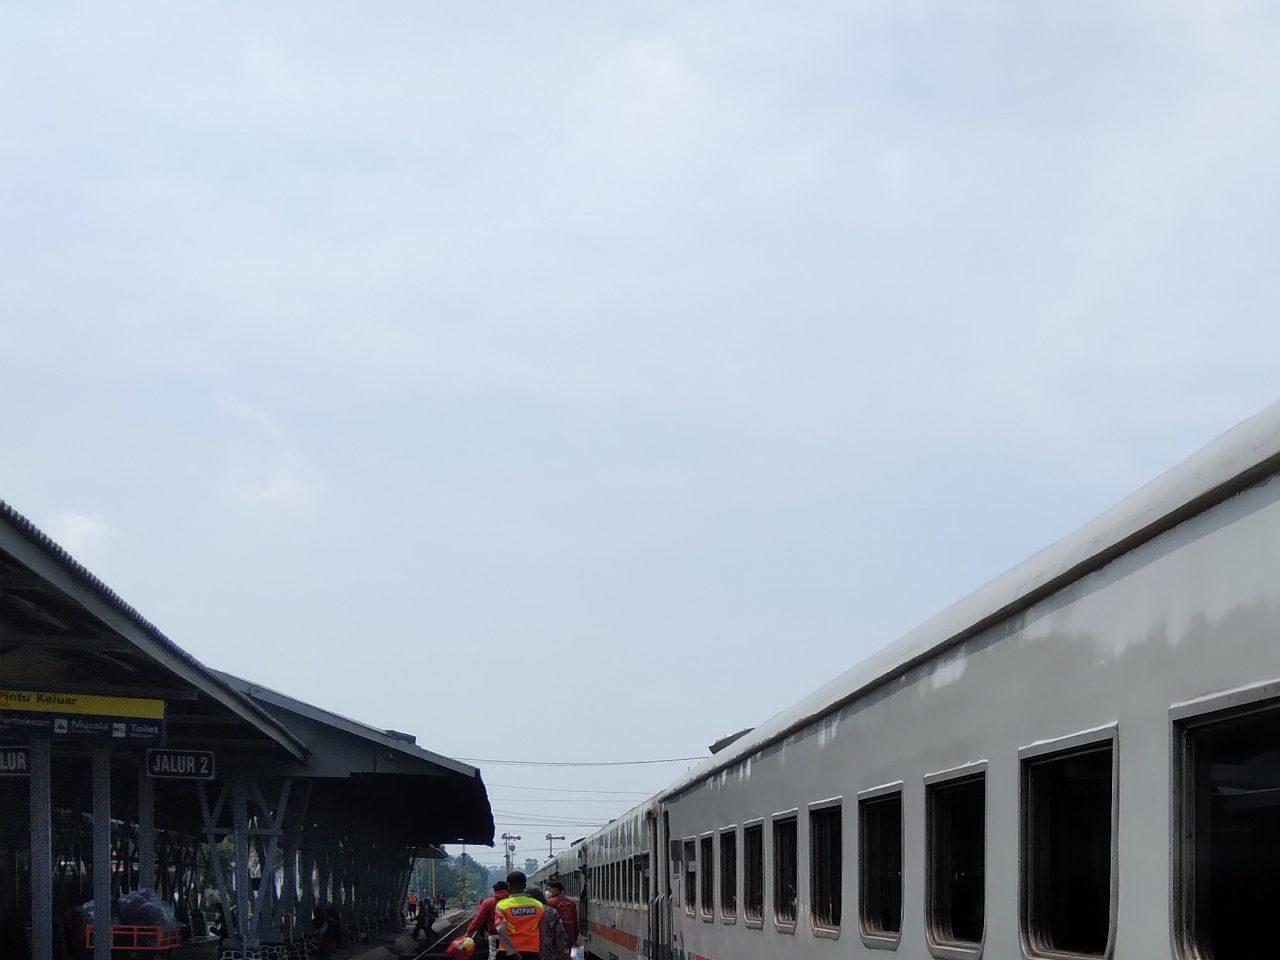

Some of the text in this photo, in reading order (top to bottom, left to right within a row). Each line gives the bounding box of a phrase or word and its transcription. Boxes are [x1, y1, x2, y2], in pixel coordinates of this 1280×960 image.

[36, 693, 78, 705] Keluar
[130, 723, 159, 734] Toilet
[152, 754, 209, 774] JALUR 2
